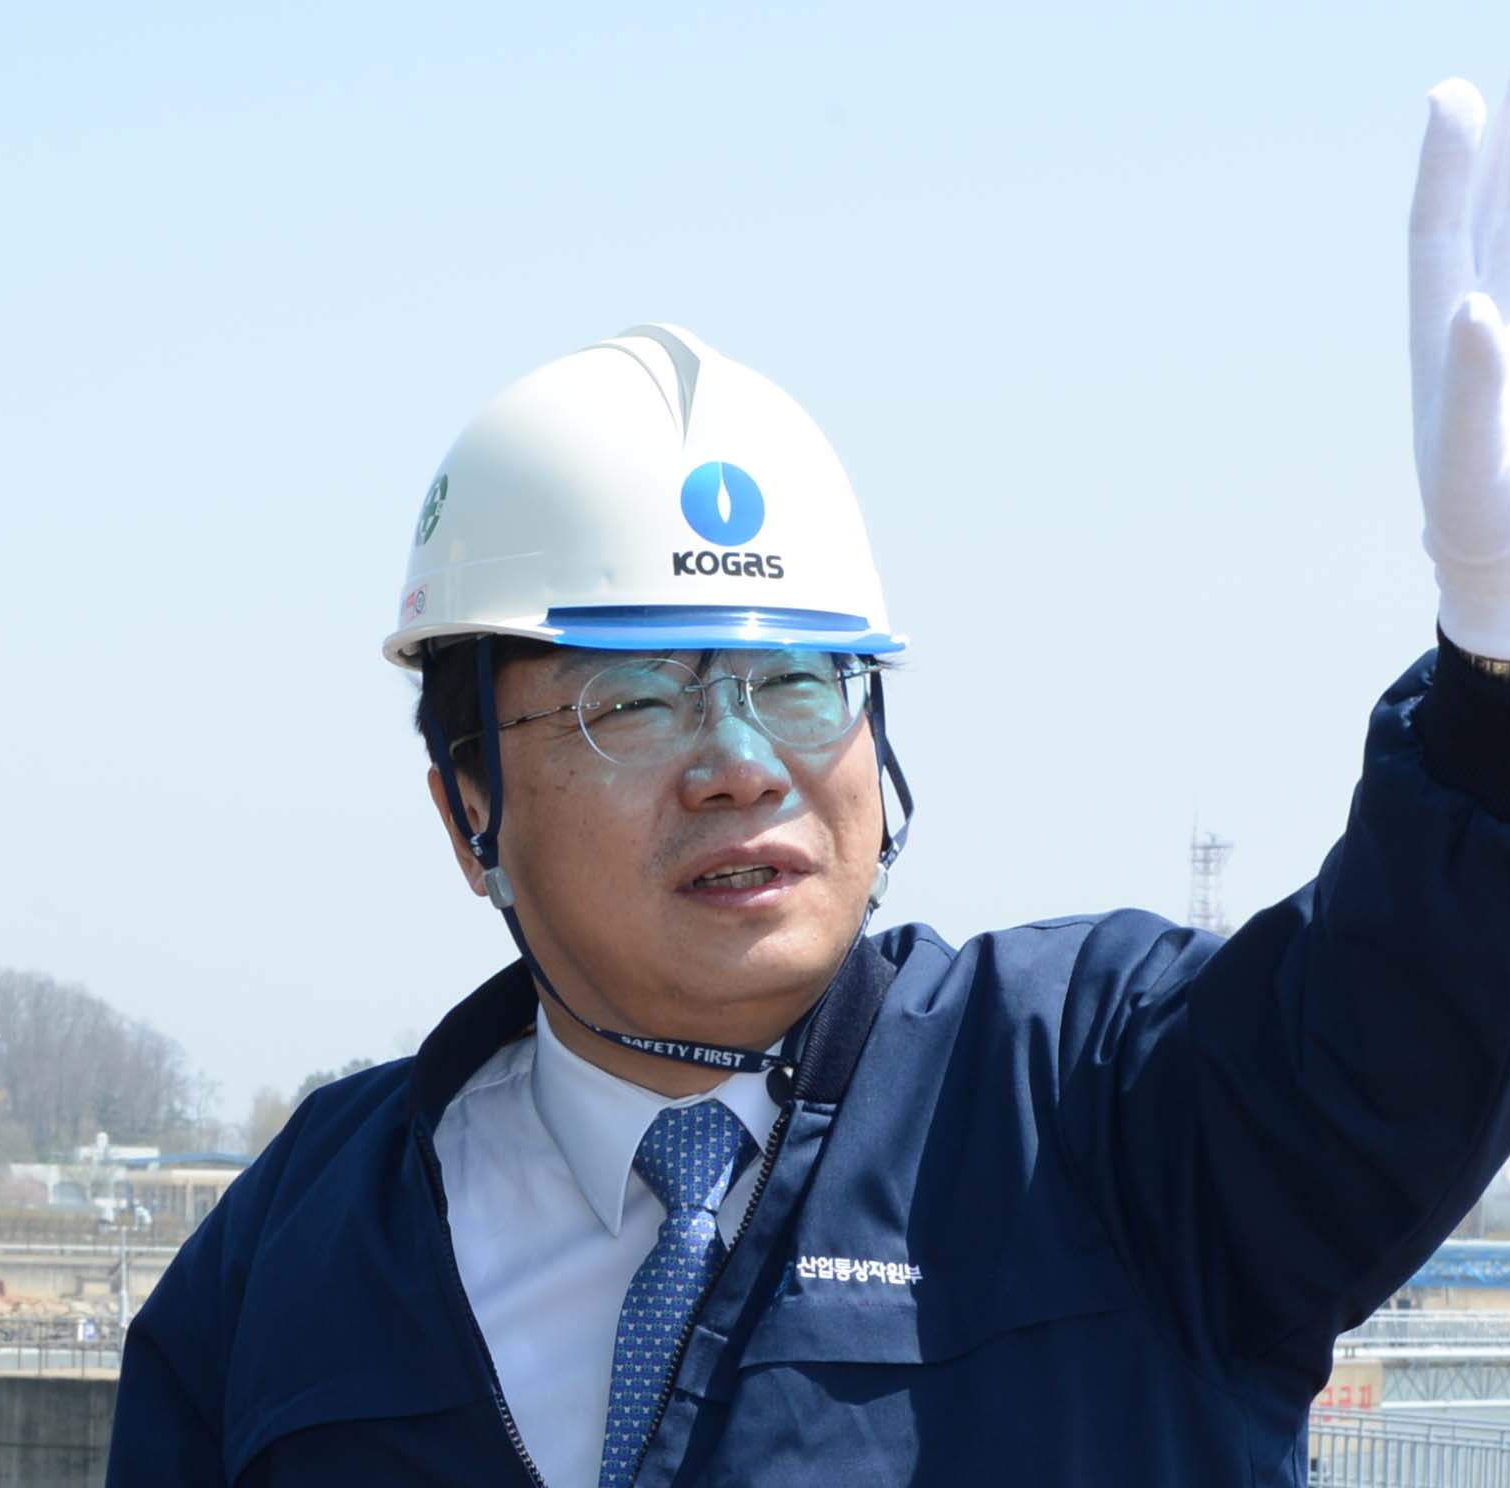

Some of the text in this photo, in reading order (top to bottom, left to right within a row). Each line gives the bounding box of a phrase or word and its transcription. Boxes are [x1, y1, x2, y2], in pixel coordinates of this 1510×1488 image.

[621, 1035, 689, 1057] SAFETY
[693, 1047, 745, 1068] FIRST
[796, 1255, 924, 1285] 산업통상자원부
